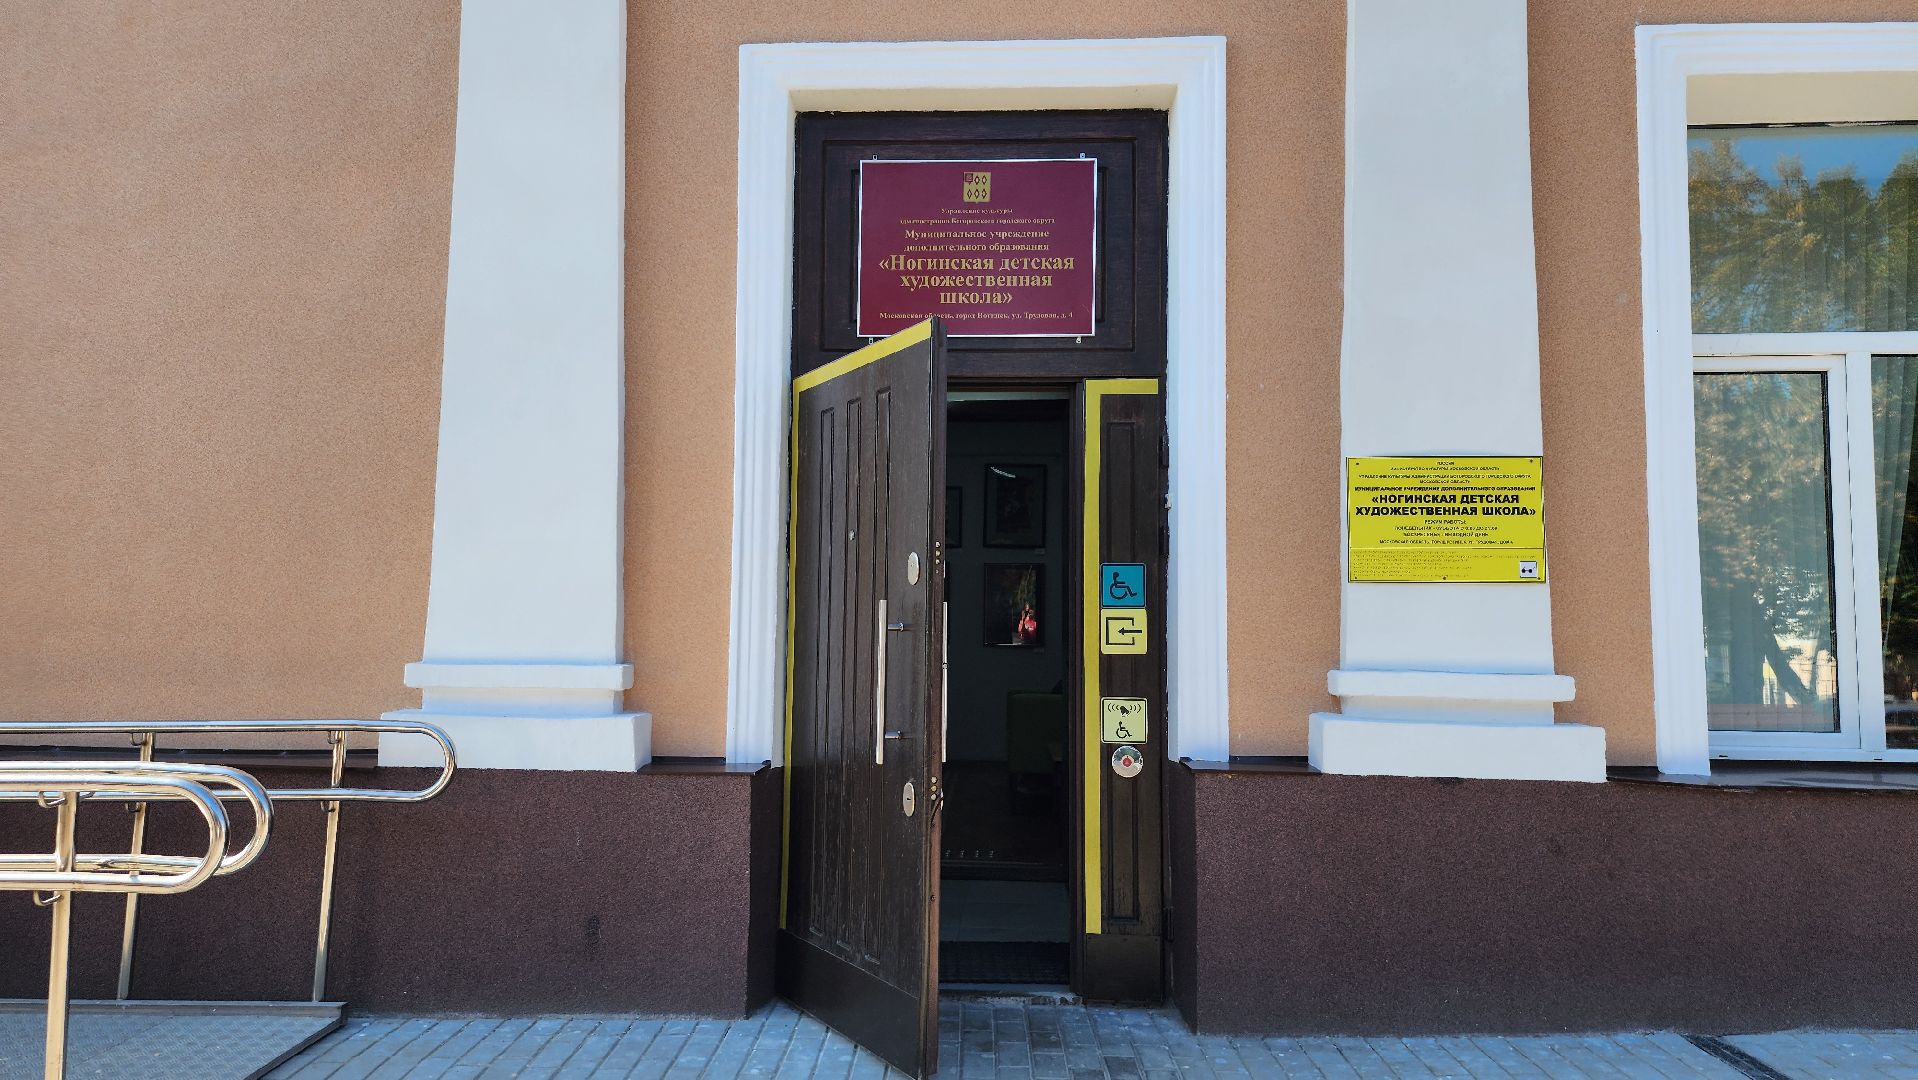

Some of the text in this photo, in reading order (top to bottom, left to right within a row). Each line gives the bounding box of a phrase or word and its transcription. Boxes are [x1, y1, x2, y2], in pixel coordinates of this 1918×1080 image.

[904, 229, 1050, 240] Муниципальное учреждение
[904, 242, 1049, 253] дополнительного образования
[879, 254, 1075, 271] «Ногинская детская
[900, 275, 1053, 292] художественная
[940, 292, 1013, 304] школа»
[1372, 494, 1520, 504] «НОГИНСКАЯ ДЕТСКАЯ
[1356, 506, 1536, 516] ХУДОЖЕСТВЕННАЯ ШКОЛА»
